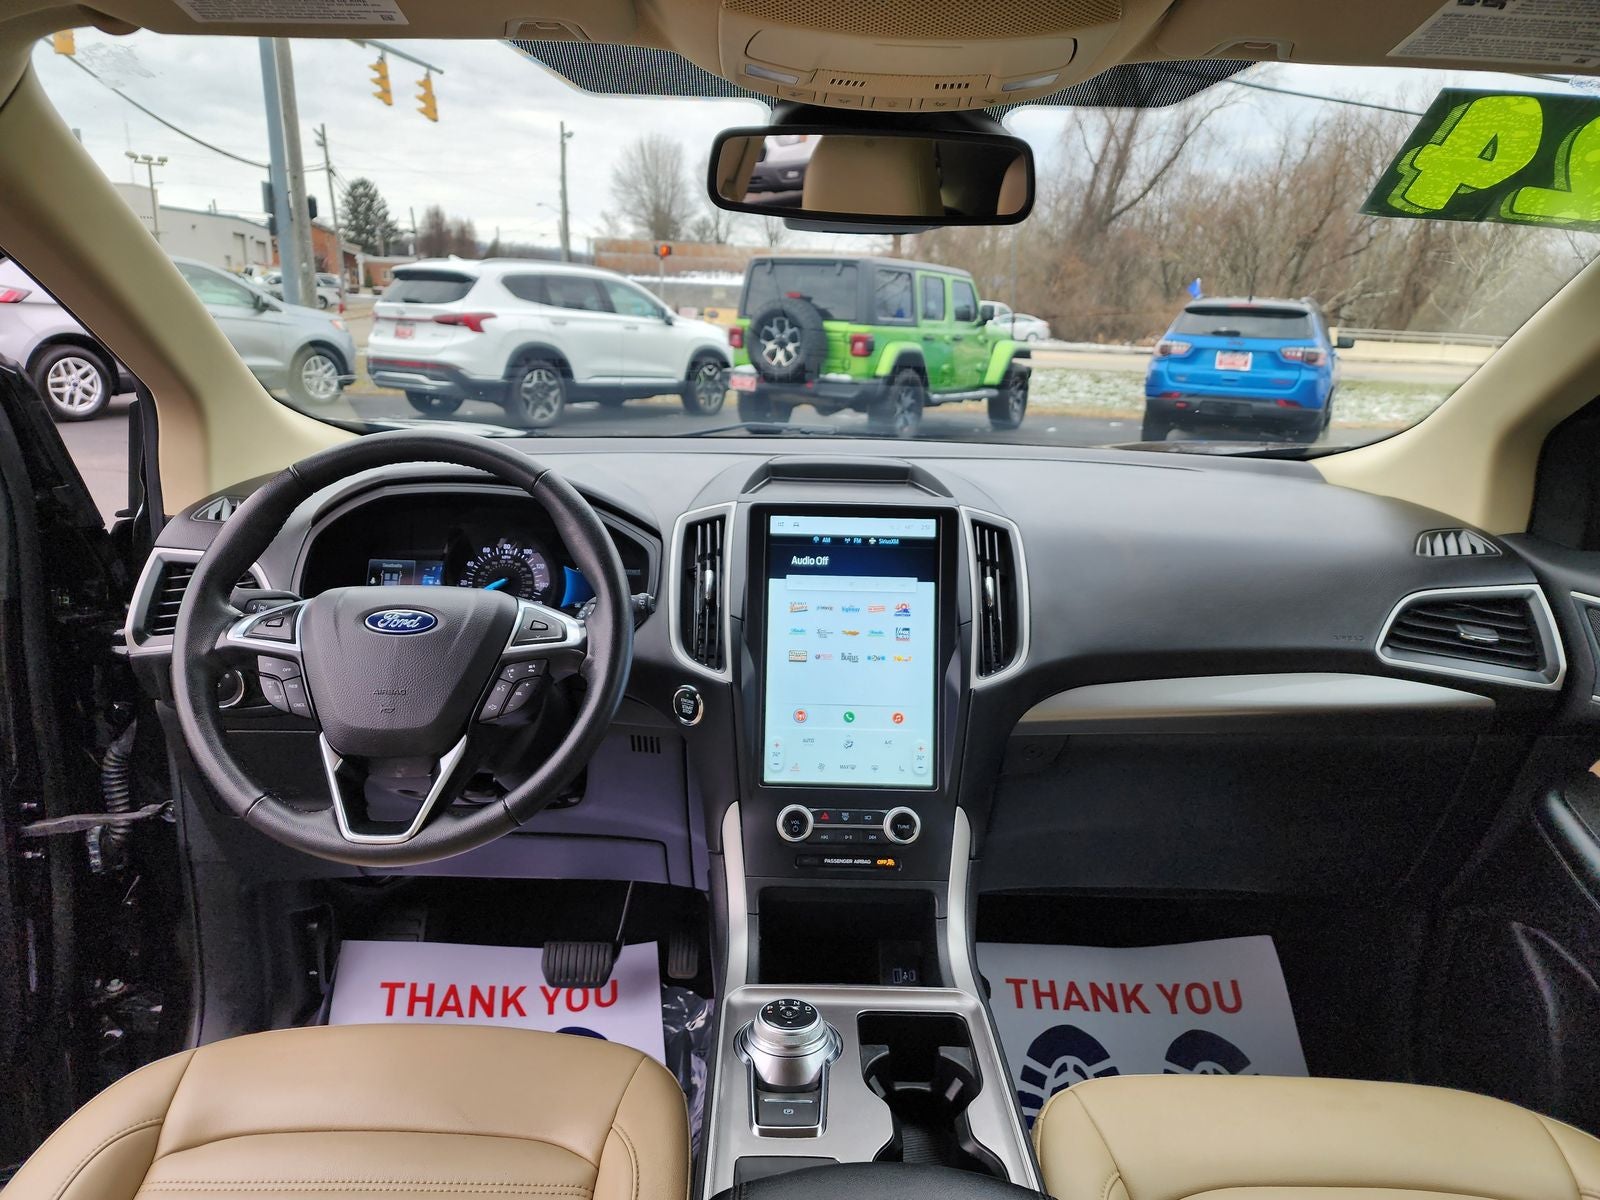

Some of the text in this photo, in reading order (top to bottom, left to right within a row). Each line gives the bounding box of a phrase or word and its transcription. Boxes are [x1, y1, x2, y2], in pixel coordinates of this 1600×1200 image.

[791, 556, 830, 566] Audio Off
[377, 611, 422, 629] Ford
[380, 979, 618, 1018] THANK YOU
[1005, 977, 1243, 1015] THANK YOU
